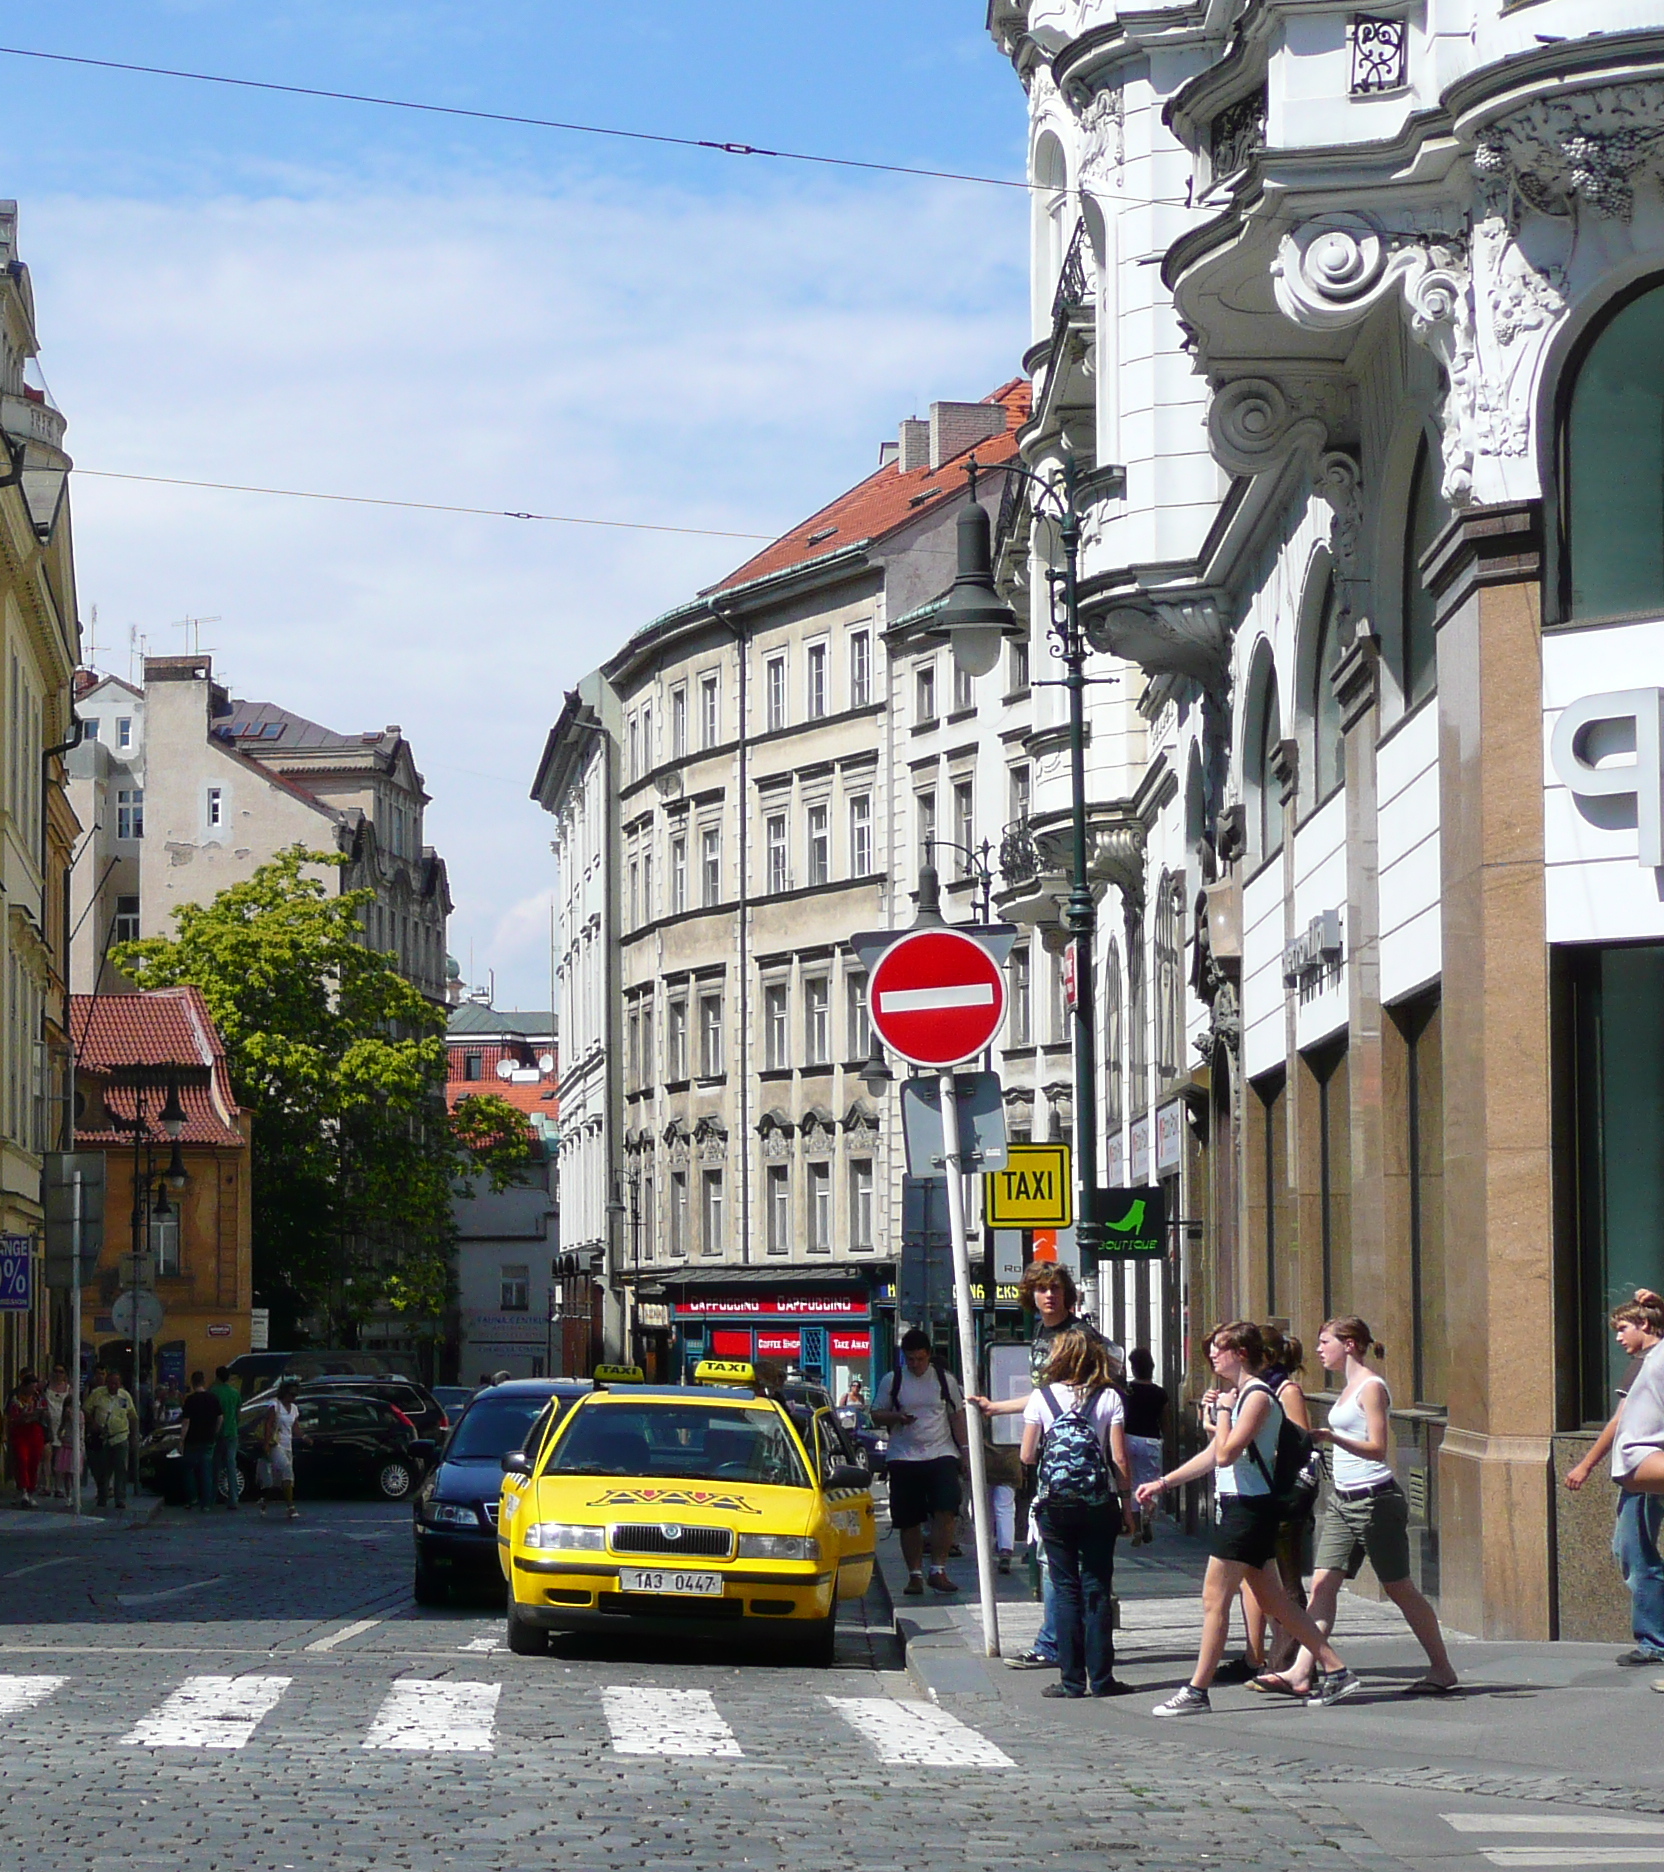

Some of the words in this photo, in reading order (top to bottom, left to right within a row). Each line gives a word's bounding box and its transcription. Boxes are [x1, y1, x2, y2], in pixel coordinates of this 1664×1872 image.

[1001, 1170, 1054, 1201] TAXI
[777, 1295, 851, 1311] CAPPUCCINO
[601, 1365, 637, 1376] TAXI
[705, 1362, 746, 1373] TAXI
[635, 1572, 663, 1590] 1A3
[675, 1574, 714, 1592] 0447
